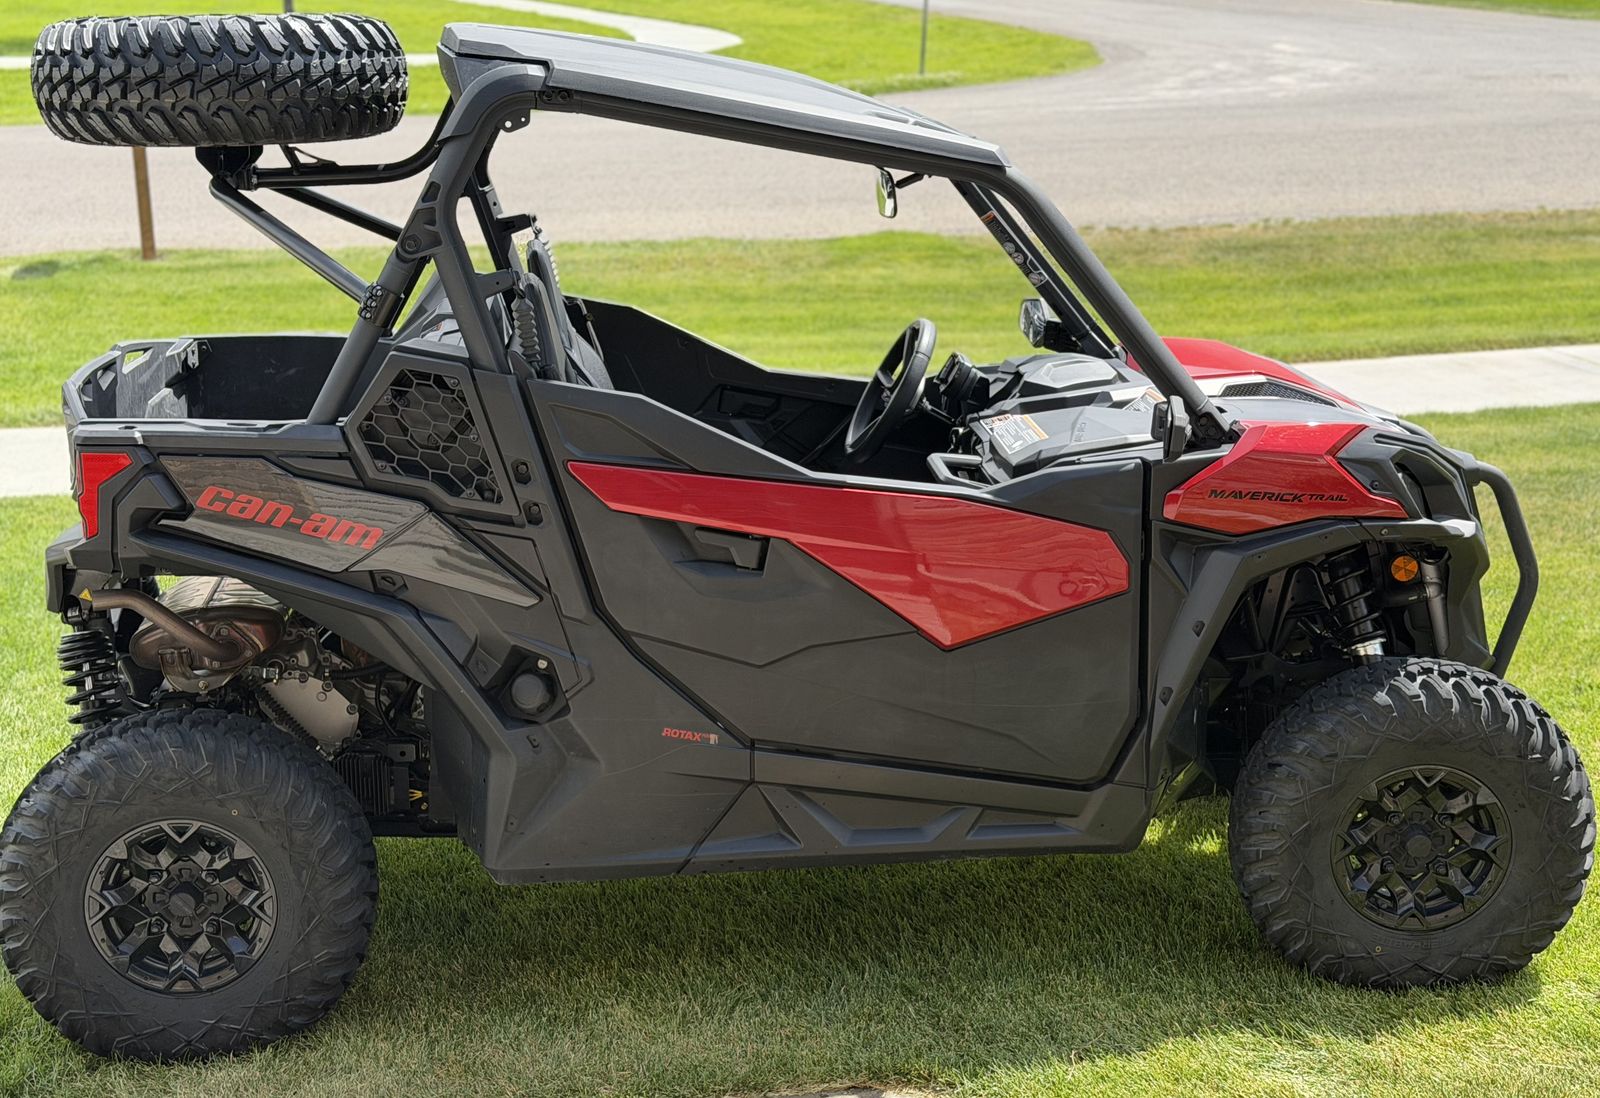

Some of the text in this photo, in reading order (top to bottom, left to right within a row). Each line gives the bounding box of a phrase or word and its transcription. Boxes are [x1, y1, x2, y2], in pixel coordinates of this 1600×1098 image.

[1208, 489, 1348, 503] MAVERICK TRAIL
[661, 727, 702, 743] ROTAX
